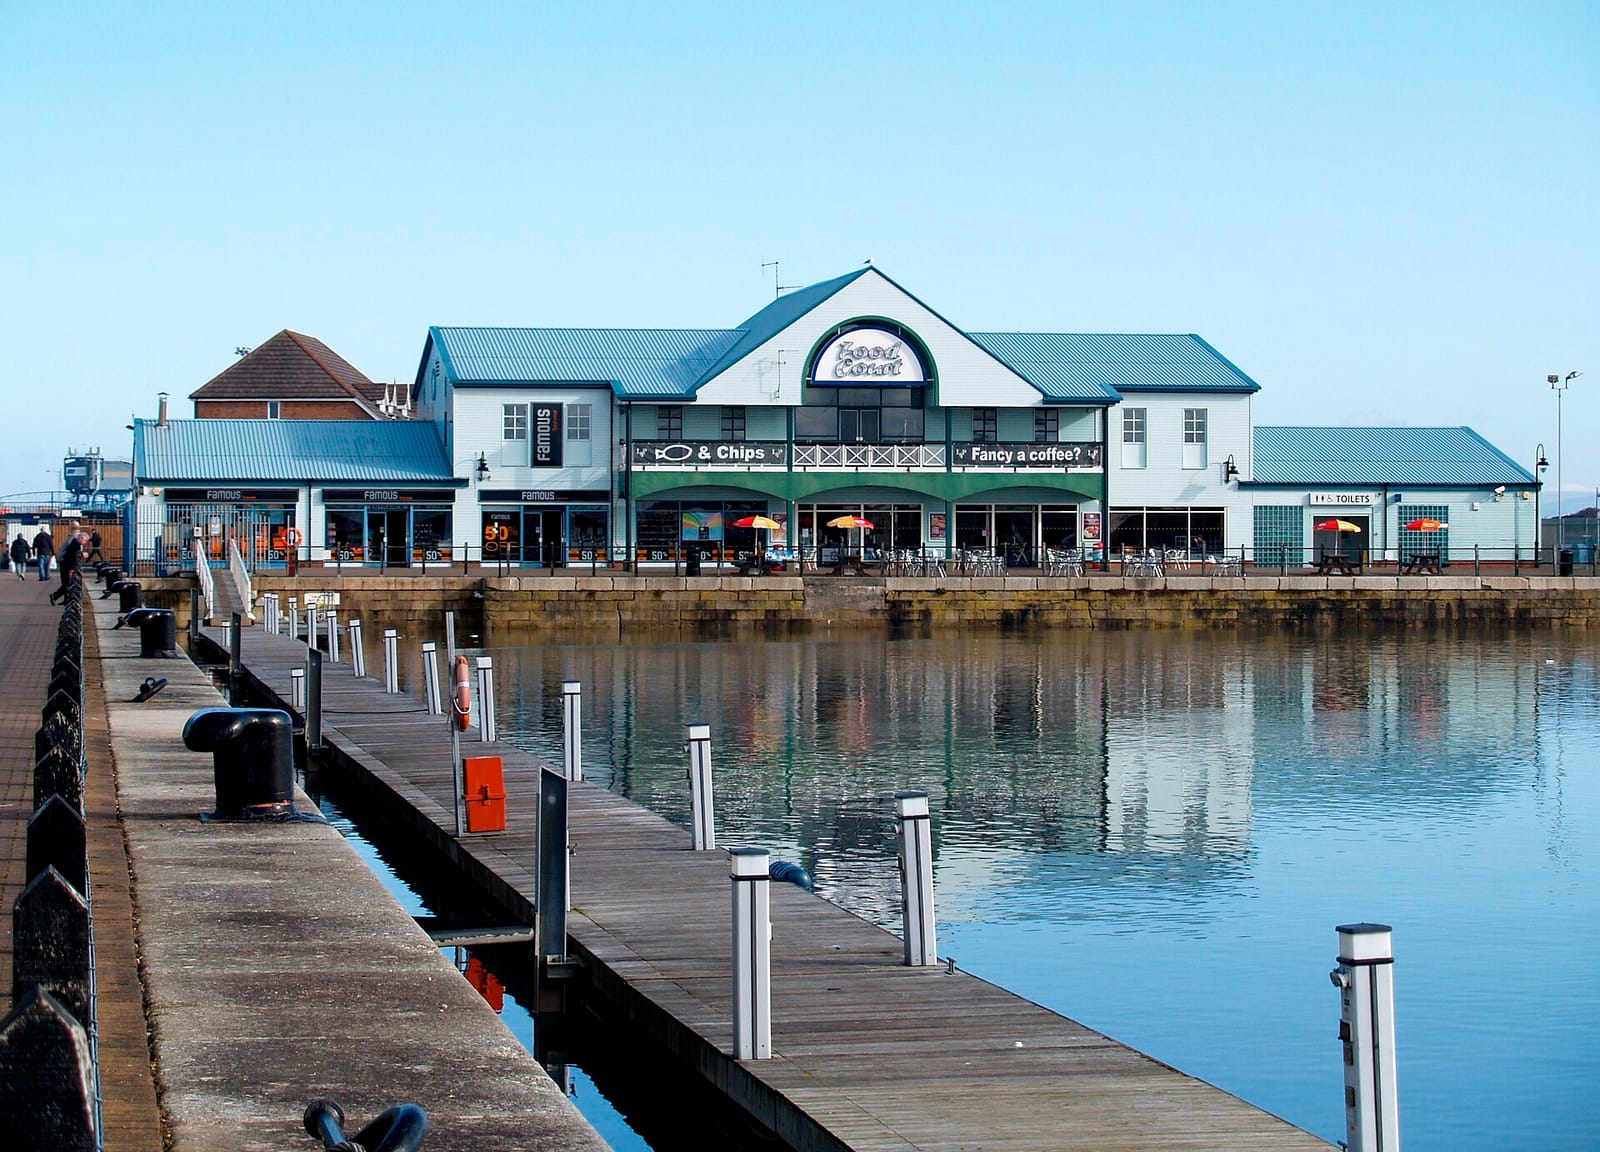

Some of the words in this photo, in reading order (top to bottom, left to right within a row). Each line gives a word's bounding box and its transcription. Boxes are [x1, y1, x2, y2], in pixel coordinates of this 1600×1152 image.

[837, 341, 902, 360] Food
[835, 359, 903, 378] Court
[698, 445, 711, 460] &
[717, 445, 765, 462] Chips
[971, 447, 1013, 463] Fancy
[1017, 450, 1026, 461] a
[1029, 447, 1082, 462] coffee?
[1336, 495, 1370, 503] TOILETS
